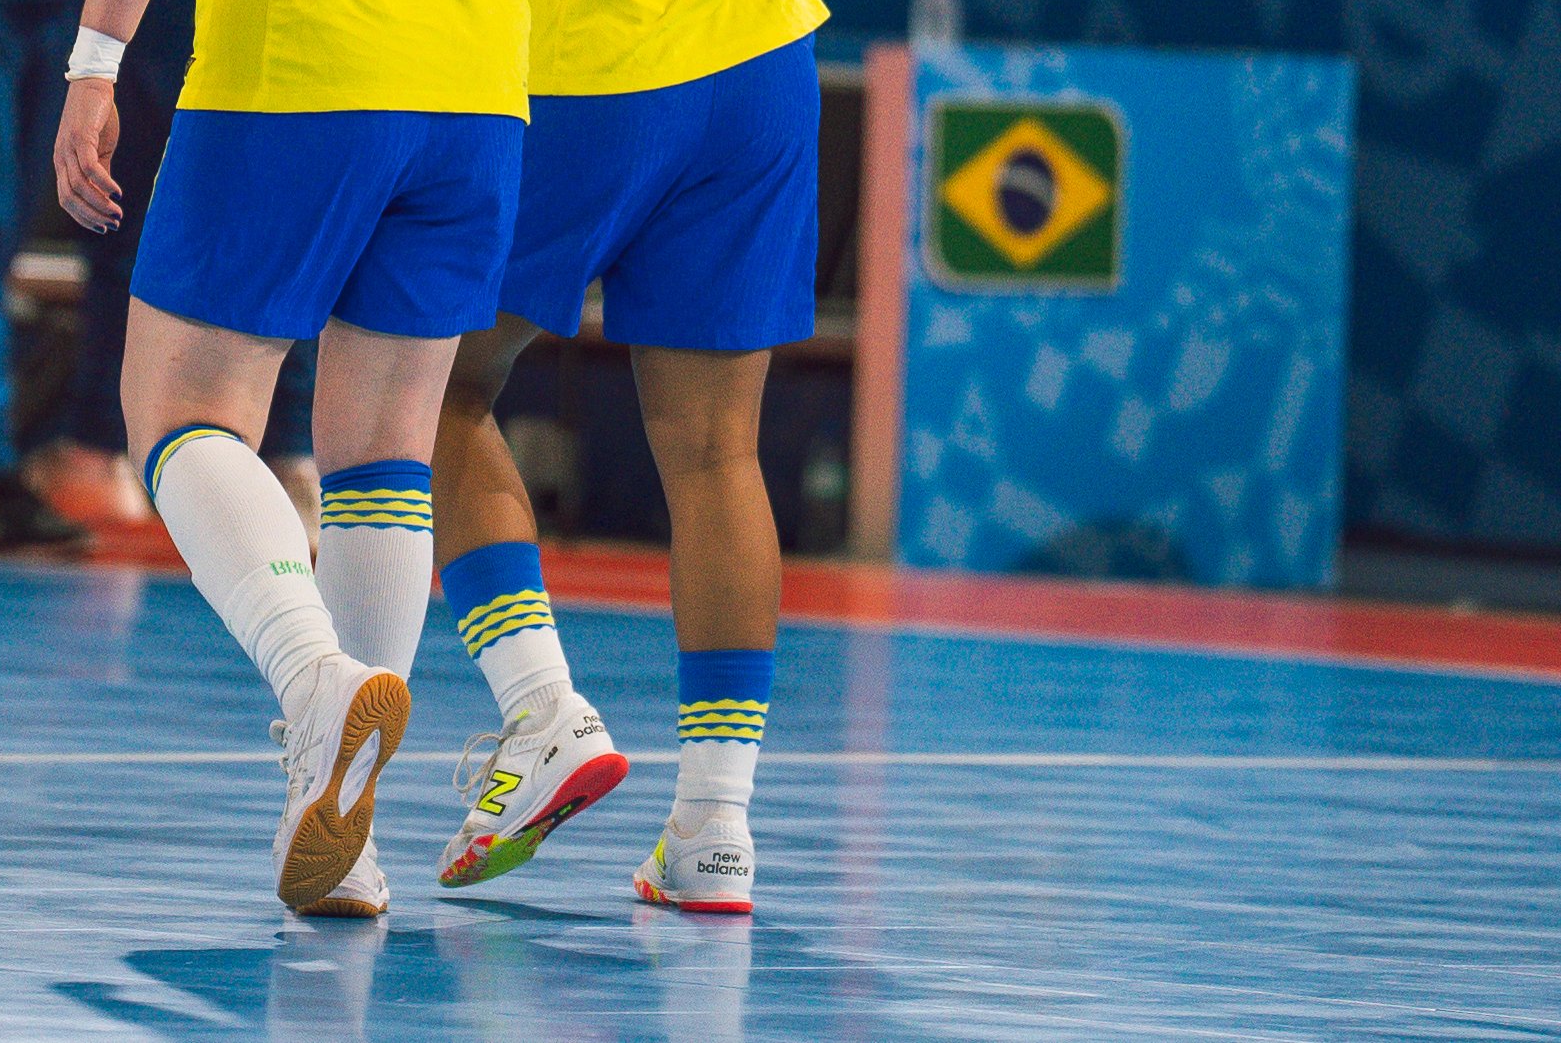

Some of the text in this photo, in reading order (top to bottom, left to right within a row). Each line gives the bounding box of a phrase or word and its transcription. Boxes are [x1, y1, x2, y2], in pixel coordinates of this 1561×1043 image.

[583, 715, 601, 724] ne
[712, 852, 741, 863] new
[697, 860, 749, 877] balance
